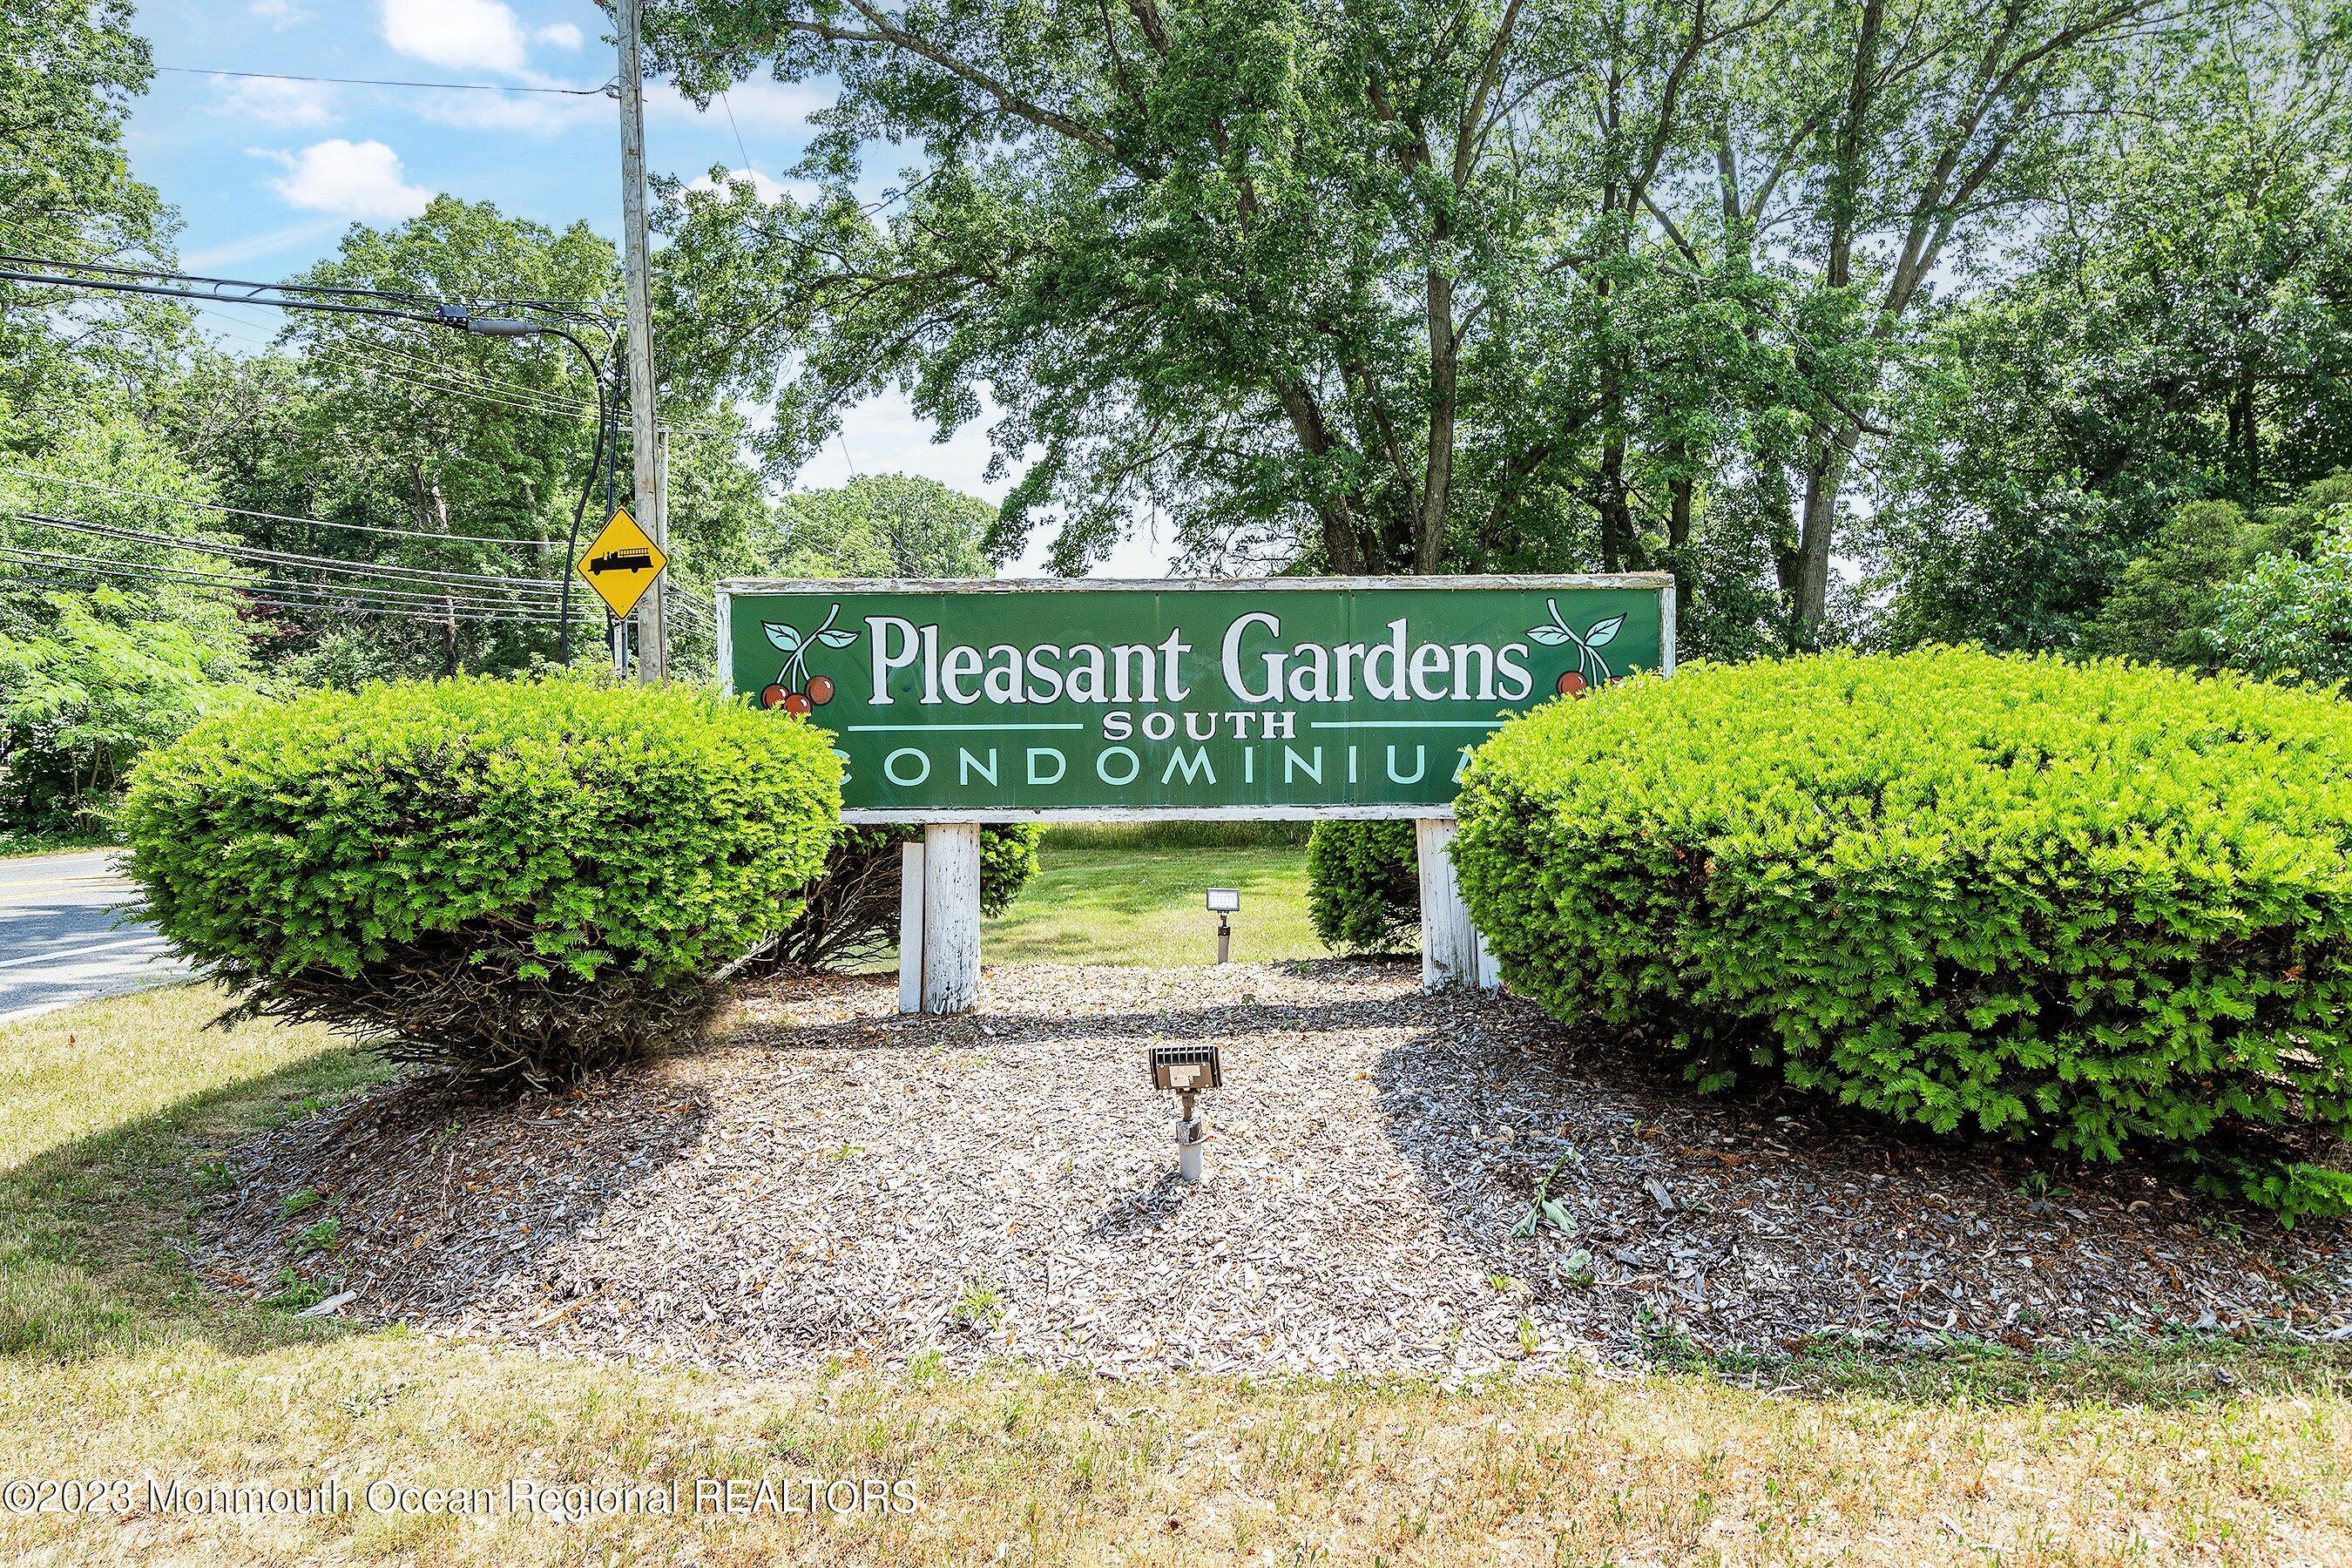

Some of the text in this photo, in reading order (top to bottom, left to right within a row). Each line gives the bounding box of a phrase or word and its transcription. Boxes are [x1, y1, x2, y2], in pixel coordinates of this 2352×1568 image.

[864, 611, 1534, 705] Pleasant Gardens
[1102, 710, 1298, 741] SOUTH
